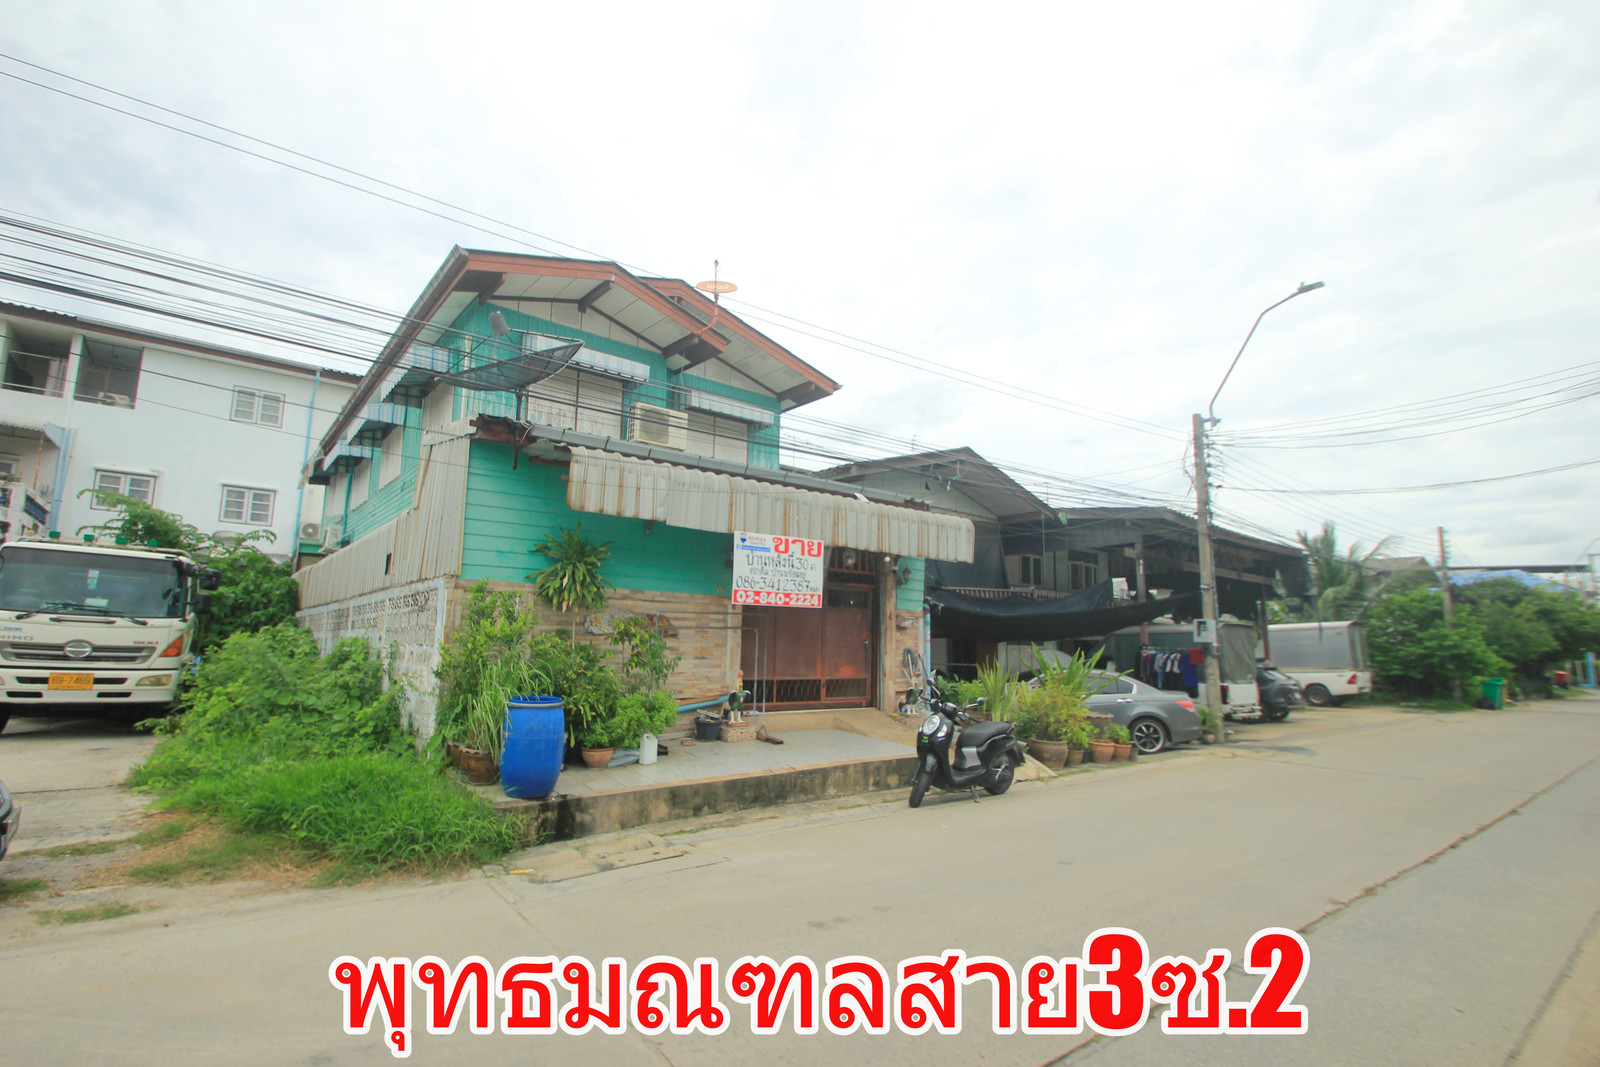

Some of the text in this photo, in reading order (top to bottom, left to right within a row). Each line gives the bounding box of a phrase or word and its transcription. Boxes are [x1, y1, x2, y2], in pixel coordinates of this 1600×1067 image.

[772, 536, 822, 558] ขาย
[736, 576, 811, 593] 086-3412387
[736, 590, 819, 606] 02-840-2224
